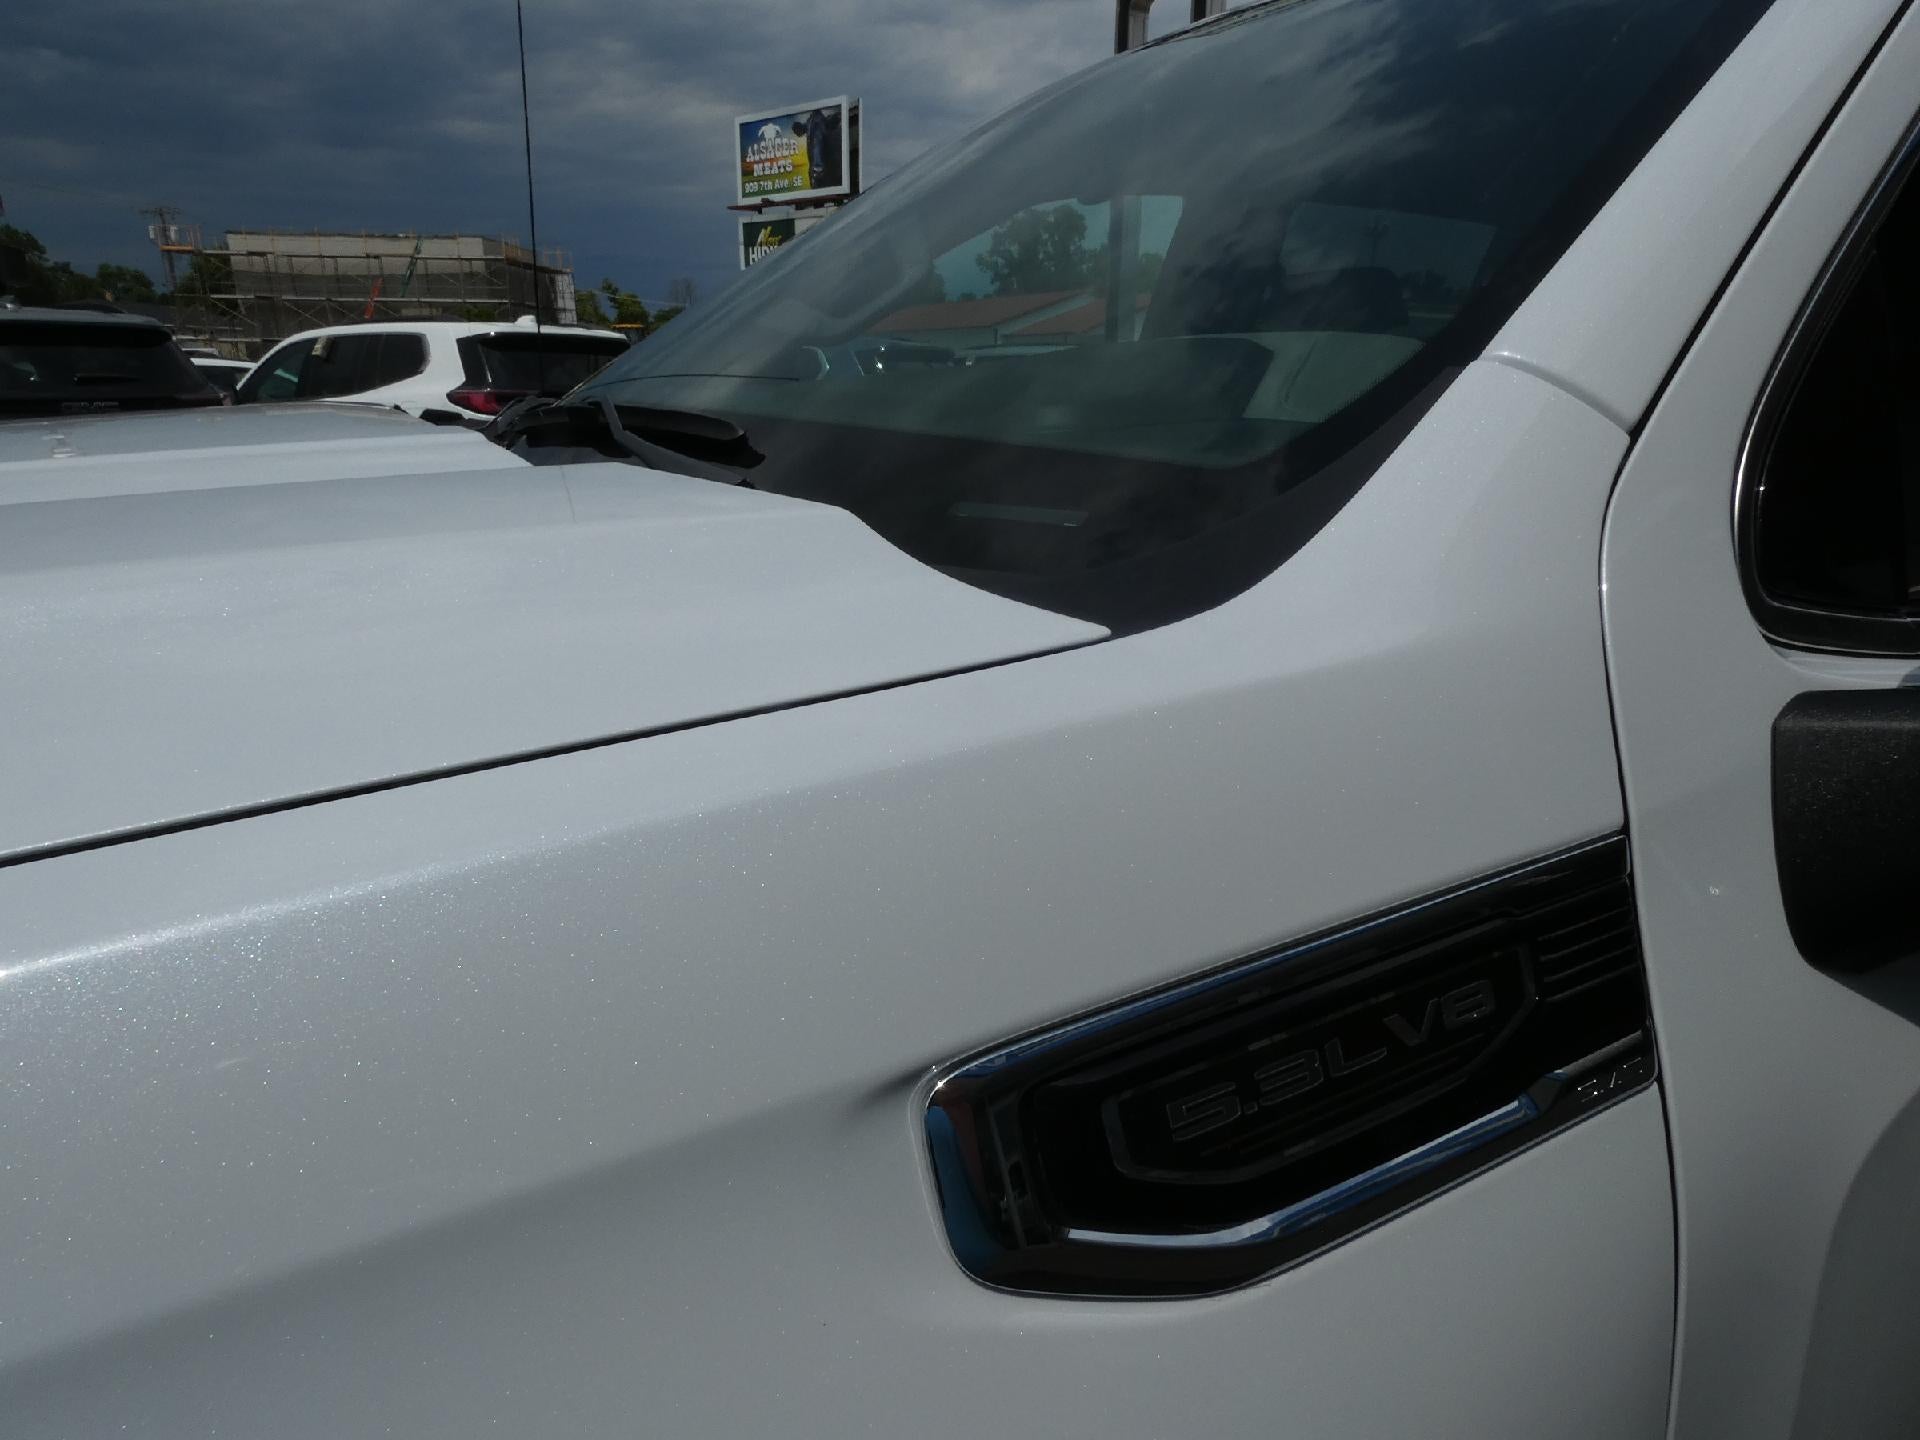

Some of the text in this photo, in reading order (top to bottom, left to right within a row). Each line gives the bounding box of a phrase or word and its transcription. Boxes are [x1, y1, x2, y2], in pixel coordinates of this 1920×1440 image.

[753, 160, 793, 177] MEATS
[760, 178, 773, 191] 7th
[792, 175, 803, 187] SE
